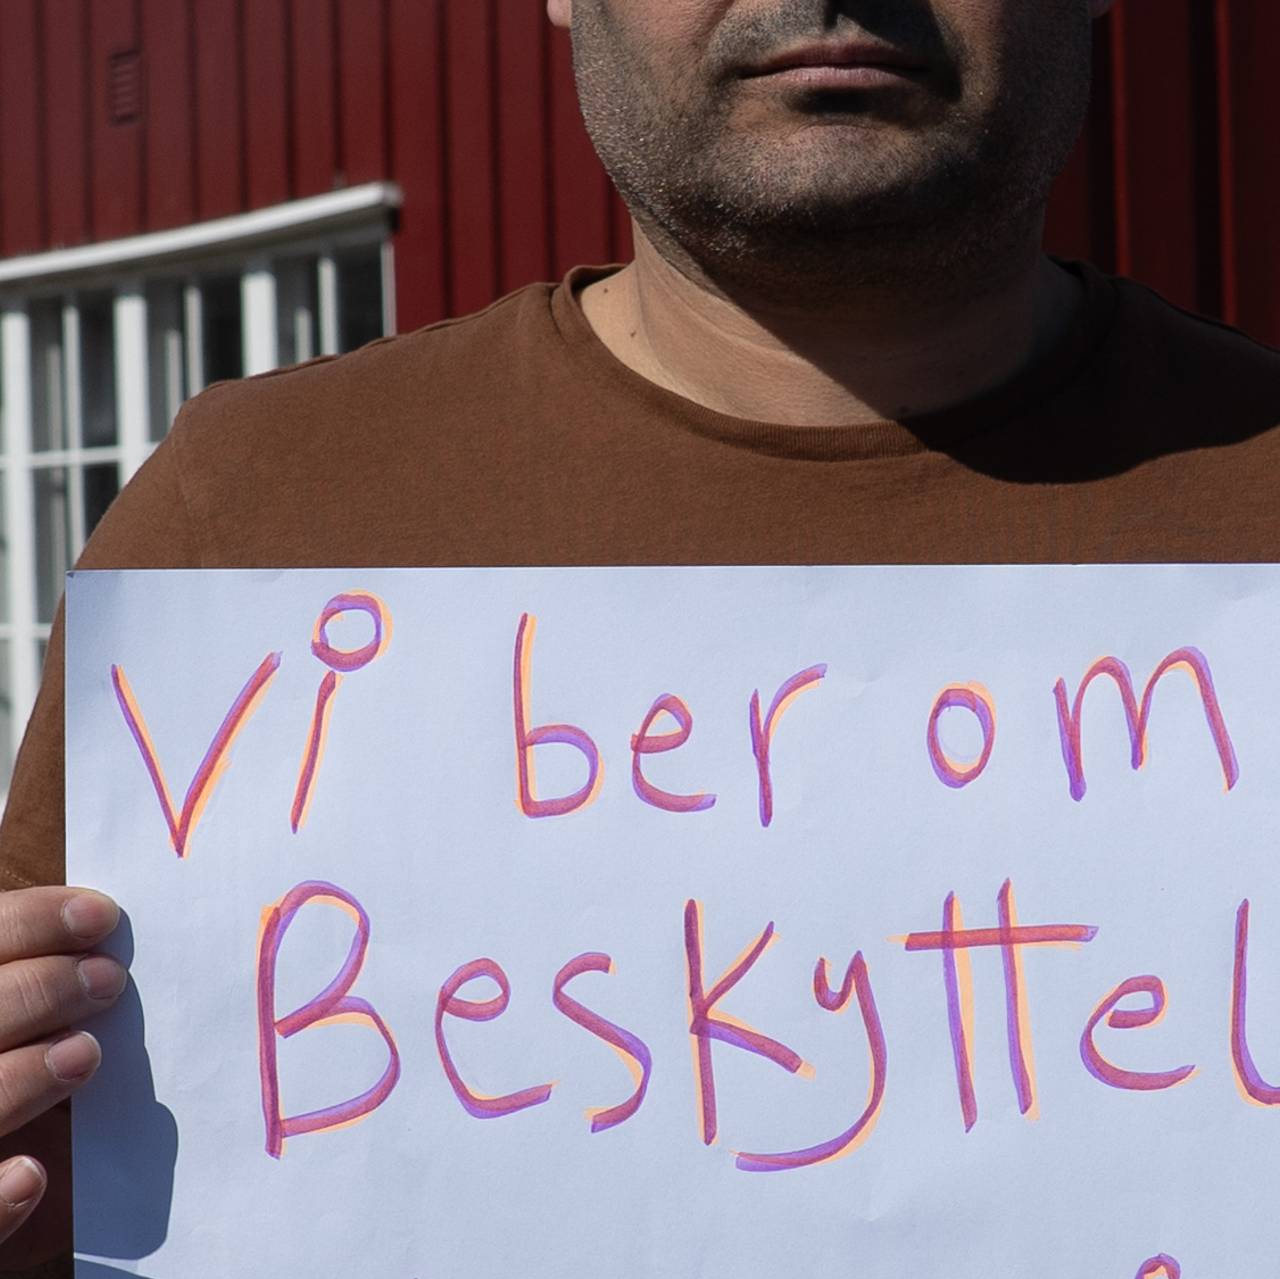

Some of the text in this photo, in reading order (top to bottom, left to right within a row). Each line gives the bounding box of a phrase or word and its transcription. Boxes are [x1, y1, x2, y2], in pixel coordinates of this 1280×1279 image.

[111, 589, 1239, 860] Vi ber om
